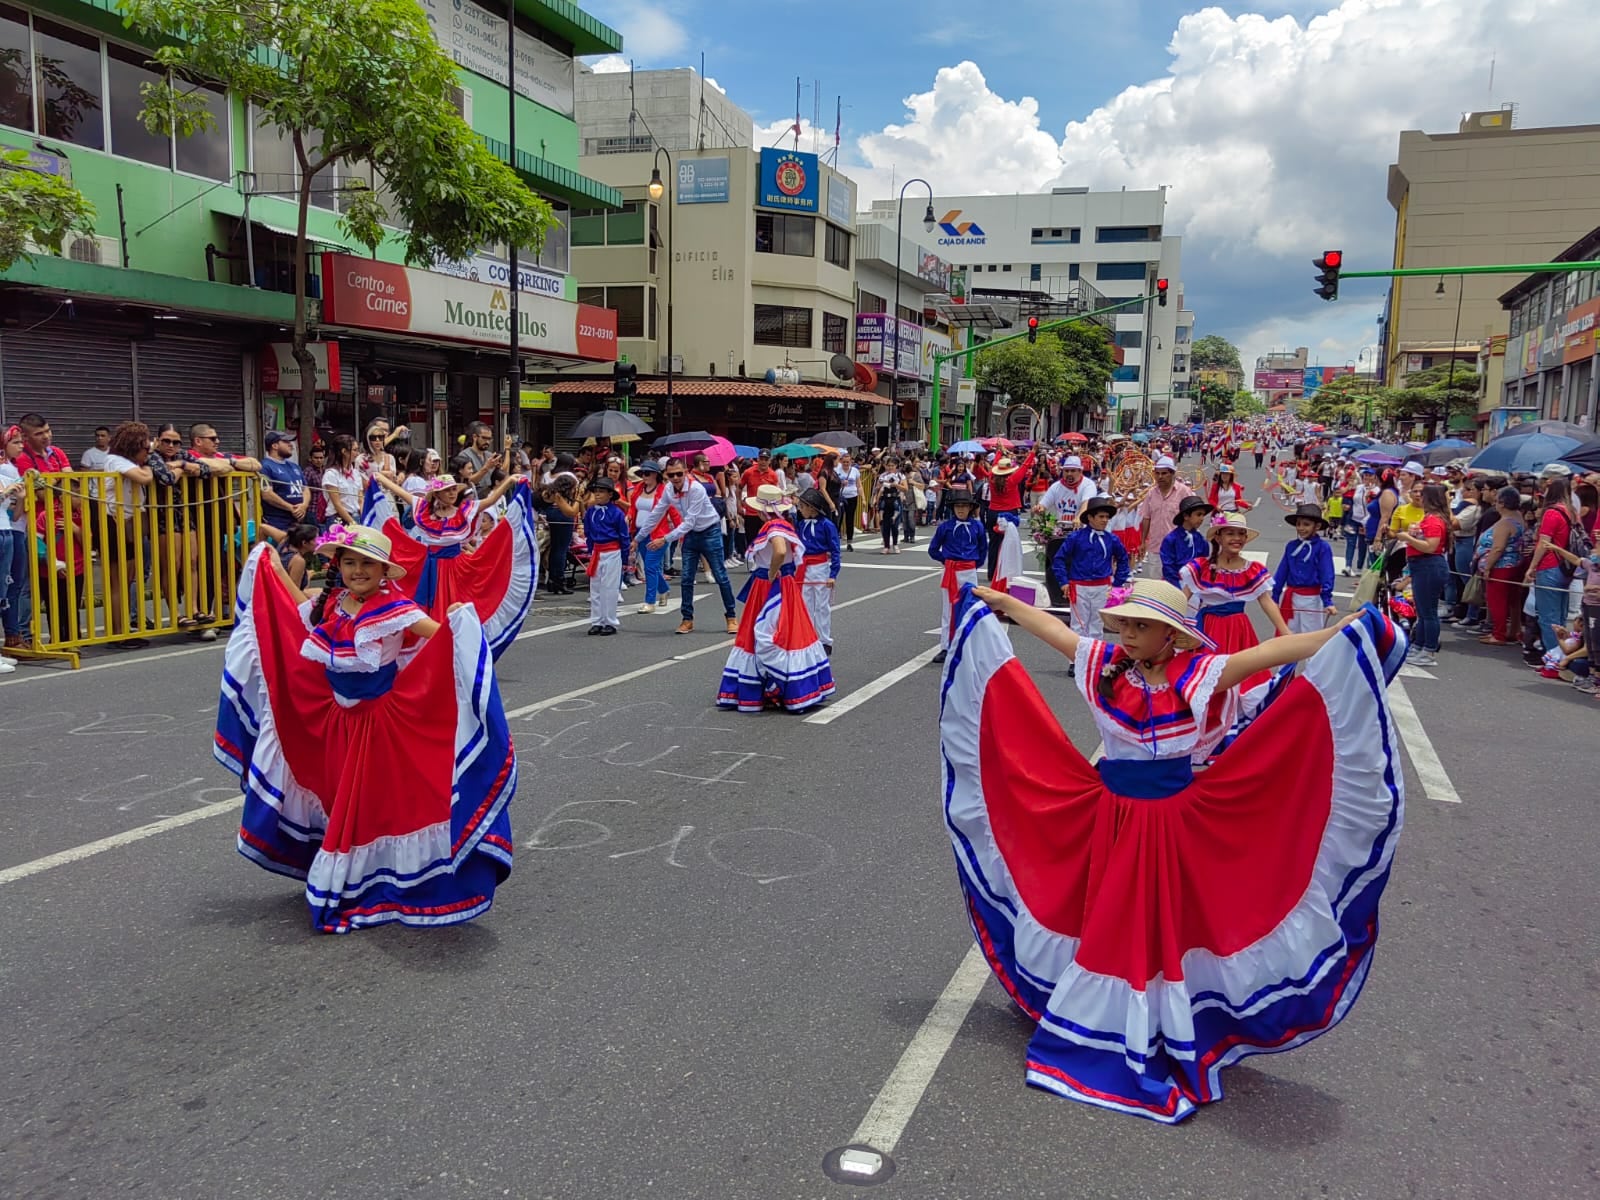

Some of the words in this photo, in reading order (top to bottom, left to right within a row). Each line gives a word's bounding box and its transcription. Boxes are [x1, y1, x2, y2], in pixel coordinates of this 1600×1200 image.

[463, 55, 494, 79] Universal
[495, 71, 504, 82] de
[937, 238, 955, 247] CAJA
[955, 238, 965, 246] DE
[965, 238, 986, 246] ANDE
[675, 250, 718, 262] DIFICIO
[347, 271, 385, 293] Centro
[385, 283, 396, 295] de
[366, 292, 408, 316] Carnes
[443, 299, 548, 339] Montecllos
[862, 317, 878, 326] ROPA
[578, 323, 614, 341] 2221-0310
[857, 325, 883, 334] AMERICANA
